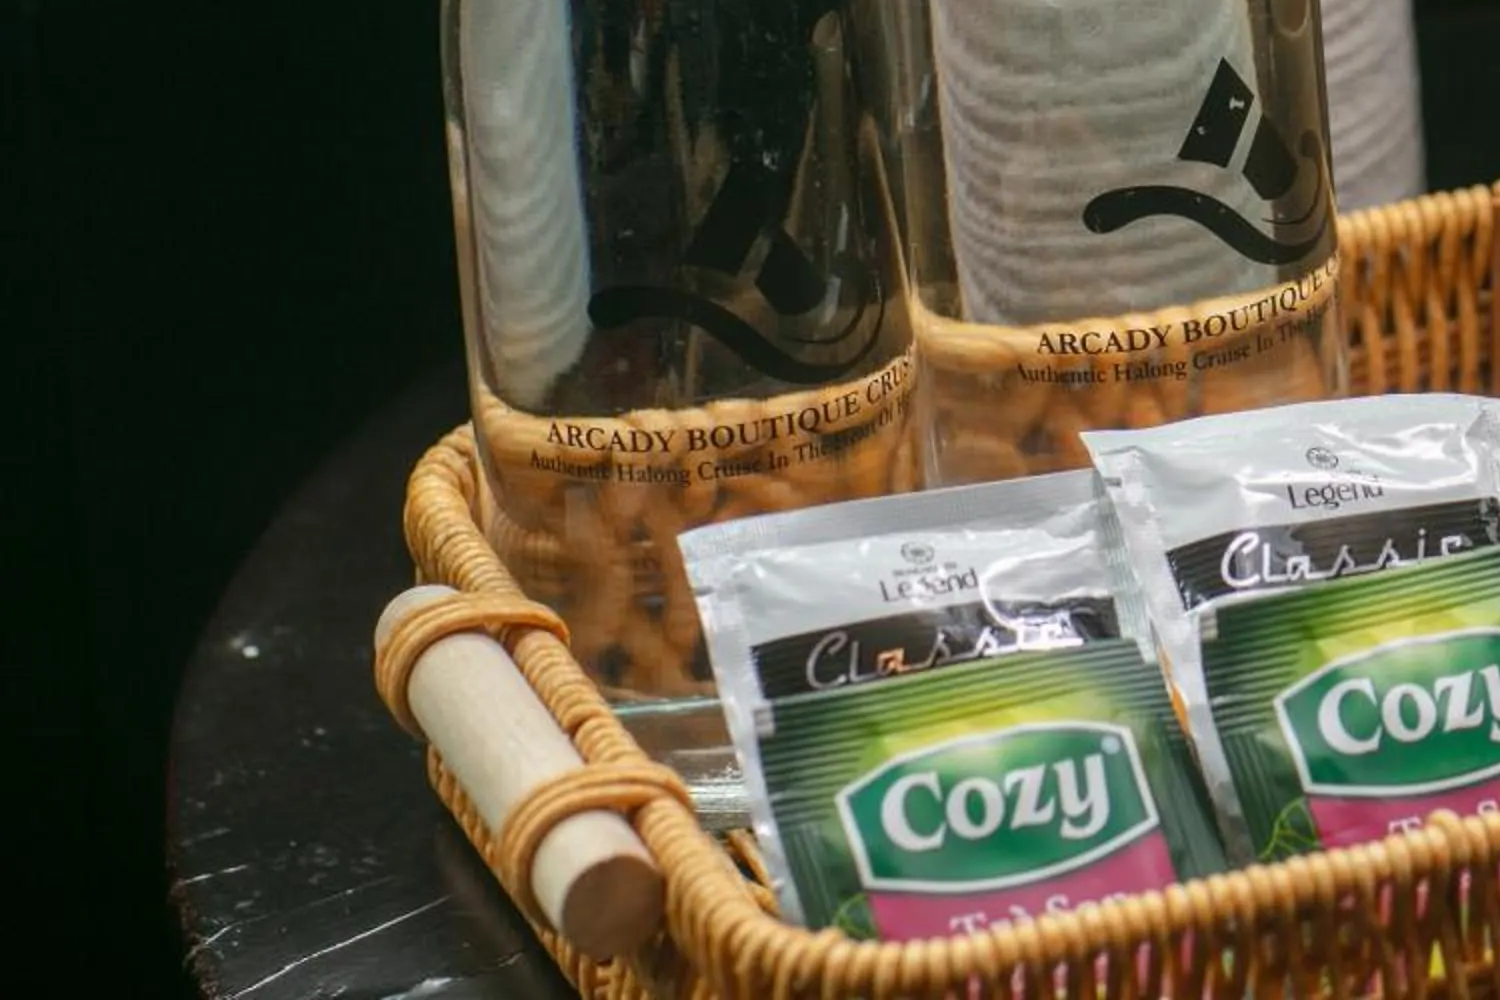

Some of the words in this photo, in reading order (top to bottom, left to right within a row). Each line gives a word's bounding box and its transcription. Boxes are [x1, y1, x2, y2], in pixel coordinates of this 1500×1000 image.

[1036, 325, 1172, 356] ARCADY
[1183, 267, 1323, 344] BOUTIQUE
[547, 420, 679, 454] ARCADY
[687, 390, 862, 453] BOUTIQUE
[866, 359, 910, 404] CRU
[1016, 361, 1107, 384] Authentic
[1114, 359, 1187, 382] Halong
[1192, 343, 1251, 371] Cruise
[529, 448, 612, 482] Authentic
[617, 462, 692, 488] Halong
[697, 459, 762, 483] Cruise
[768, 449, 790, 470] In
[880, 752, 1111, 852] Cozy
